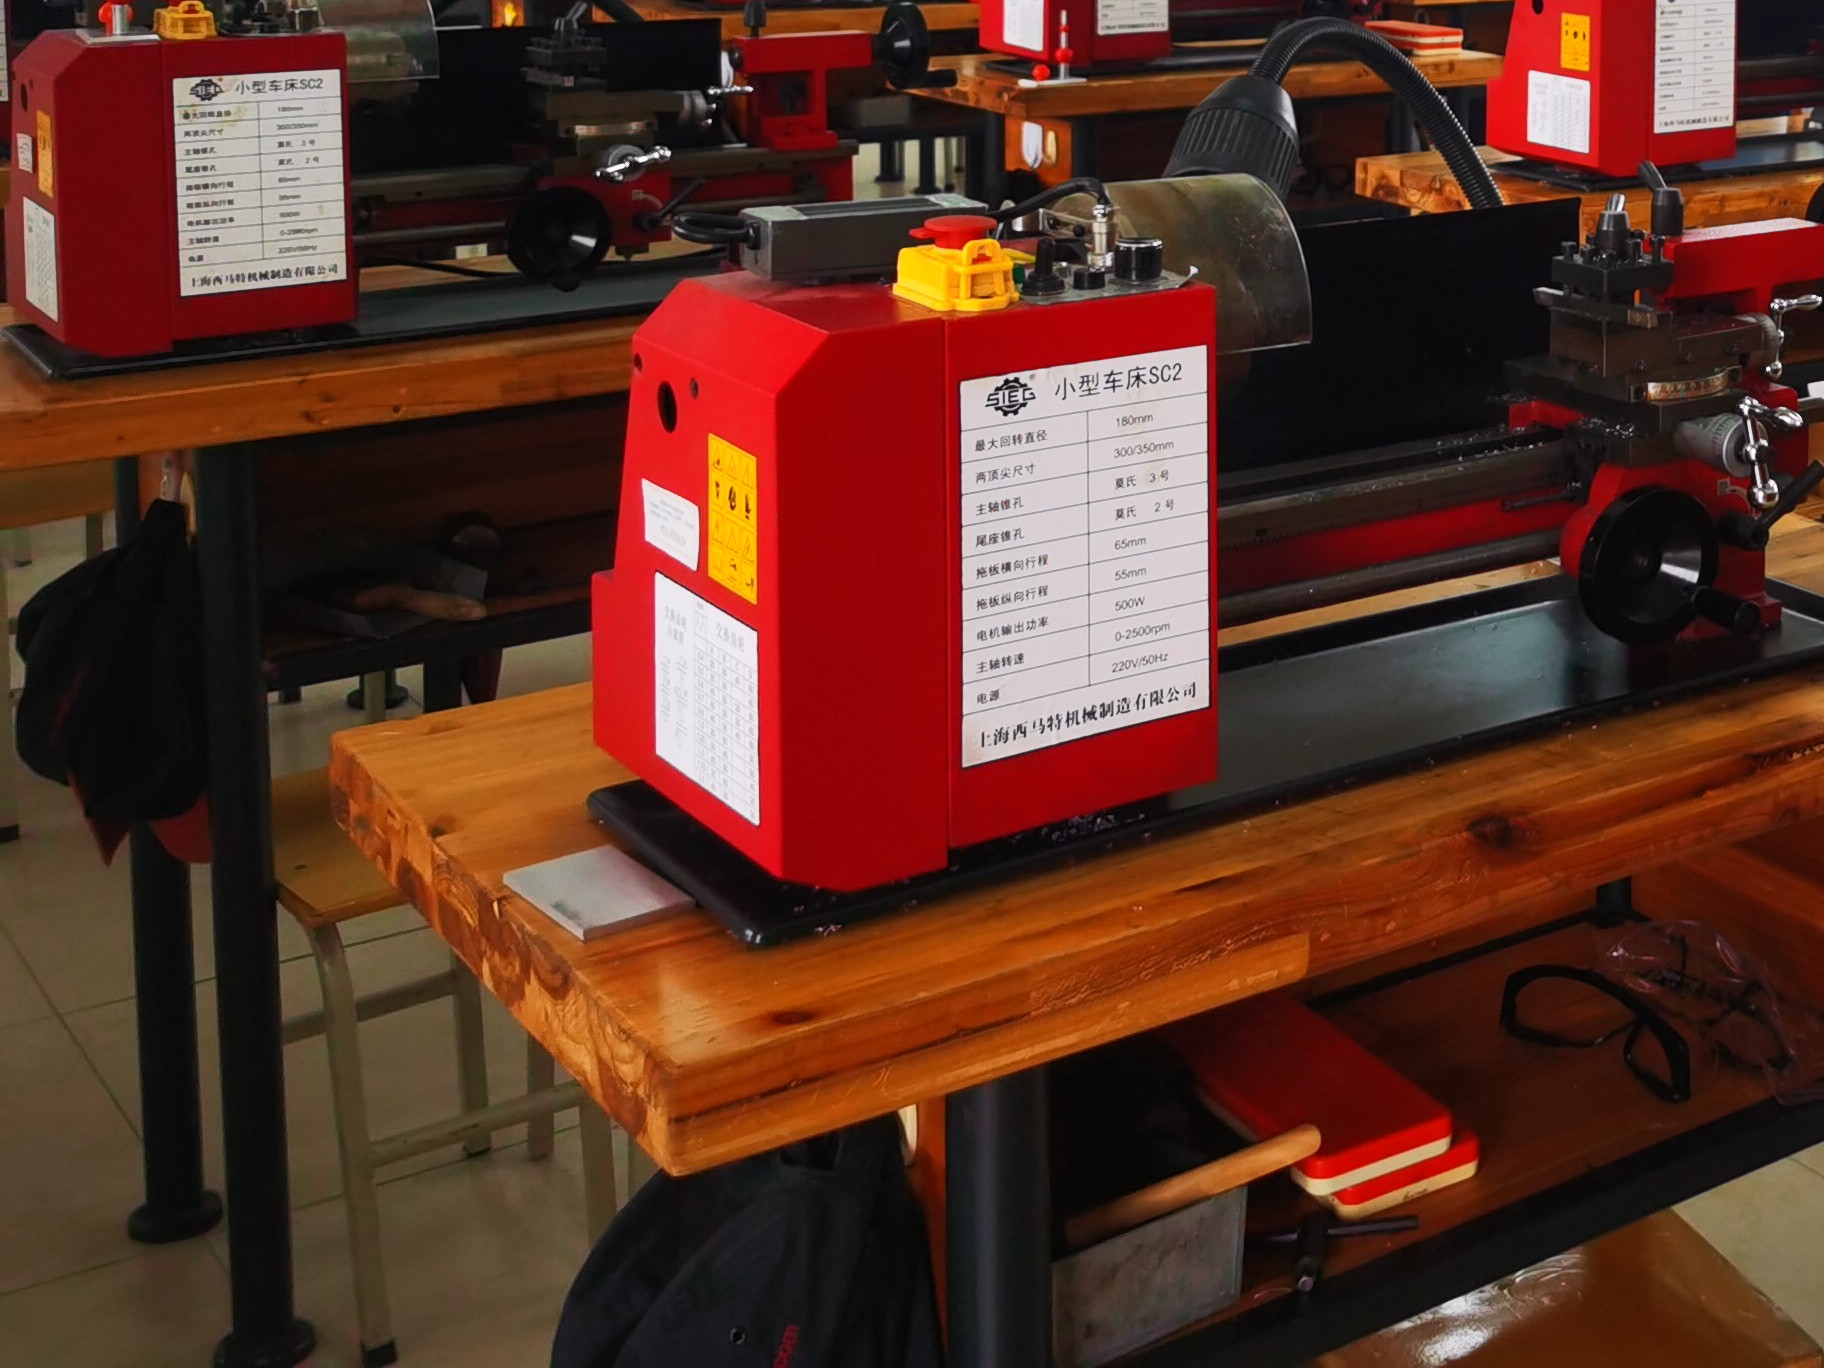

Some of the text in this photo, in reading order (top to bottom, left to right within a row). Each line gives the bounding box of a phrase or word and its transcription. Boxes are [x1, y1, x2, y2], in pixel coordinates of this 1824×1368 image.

[236, 78, 324, 95] 小型车床SC2
[1055, 363, 1182, 400] 小型车床SC2
[985, 386, 1036, 409] SIEG
[1116, 414, 1154, 427] 180mm
[975, 430, 1048, 452] 最大回转直径
[1113, 441, 1174, 458] 300/350mm
[975, 463, 1036, 484] 两顶尖尺寸
[975, 497, 1024, 516] 主轴锥孔
[975, 528, 1024, 548] 尾座锥孔
[1114, 537, 1147, 550] 65mm
[976, 554, 1048, 579] 拖板横向行程
[1114, 567, 1147, 581] 55mm
[976, 585, 1049, 611] 拖板纵向行程
[1114, 596, 1145, 612] 500W
[976, 617, 1049, 642] 电机输出功率
[1115, 622, 1170, 642] 0-2500rpm
[976, 653, 1025, 674] 主轴转速
[1112, 652, 1169, 673] 220V/50Hz
[976, 688, 1000, 705] 电源
[980, 682, 1196, 748] 上海西马特机械制造有限公司
